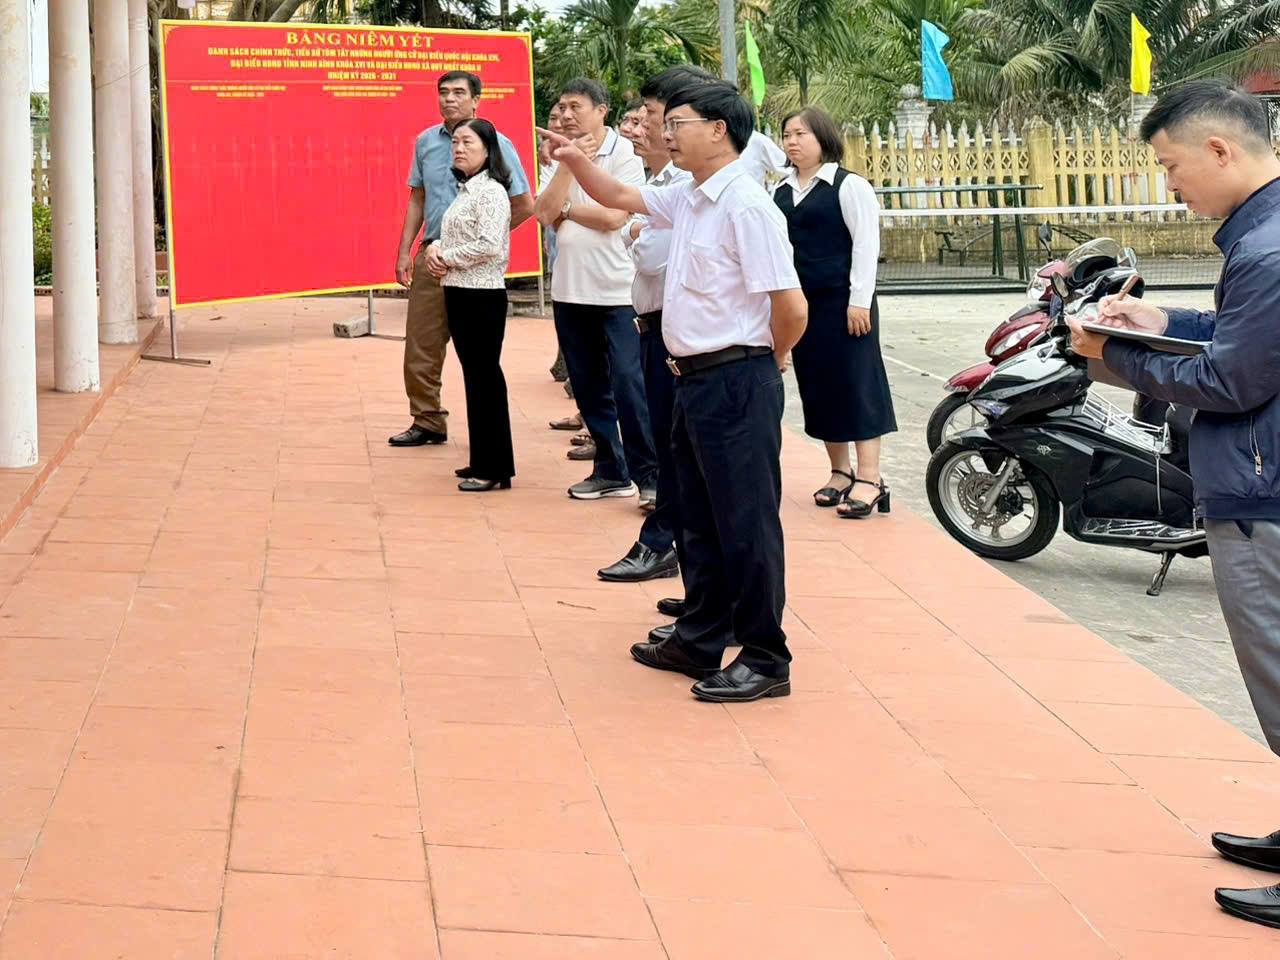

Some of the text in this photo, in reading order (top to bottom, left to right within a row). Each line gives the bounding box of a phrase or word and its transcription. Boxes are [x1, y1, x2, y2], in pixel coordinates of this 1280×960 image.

[286, 29, 434, 48] BẢNG NIÊM YẾT
